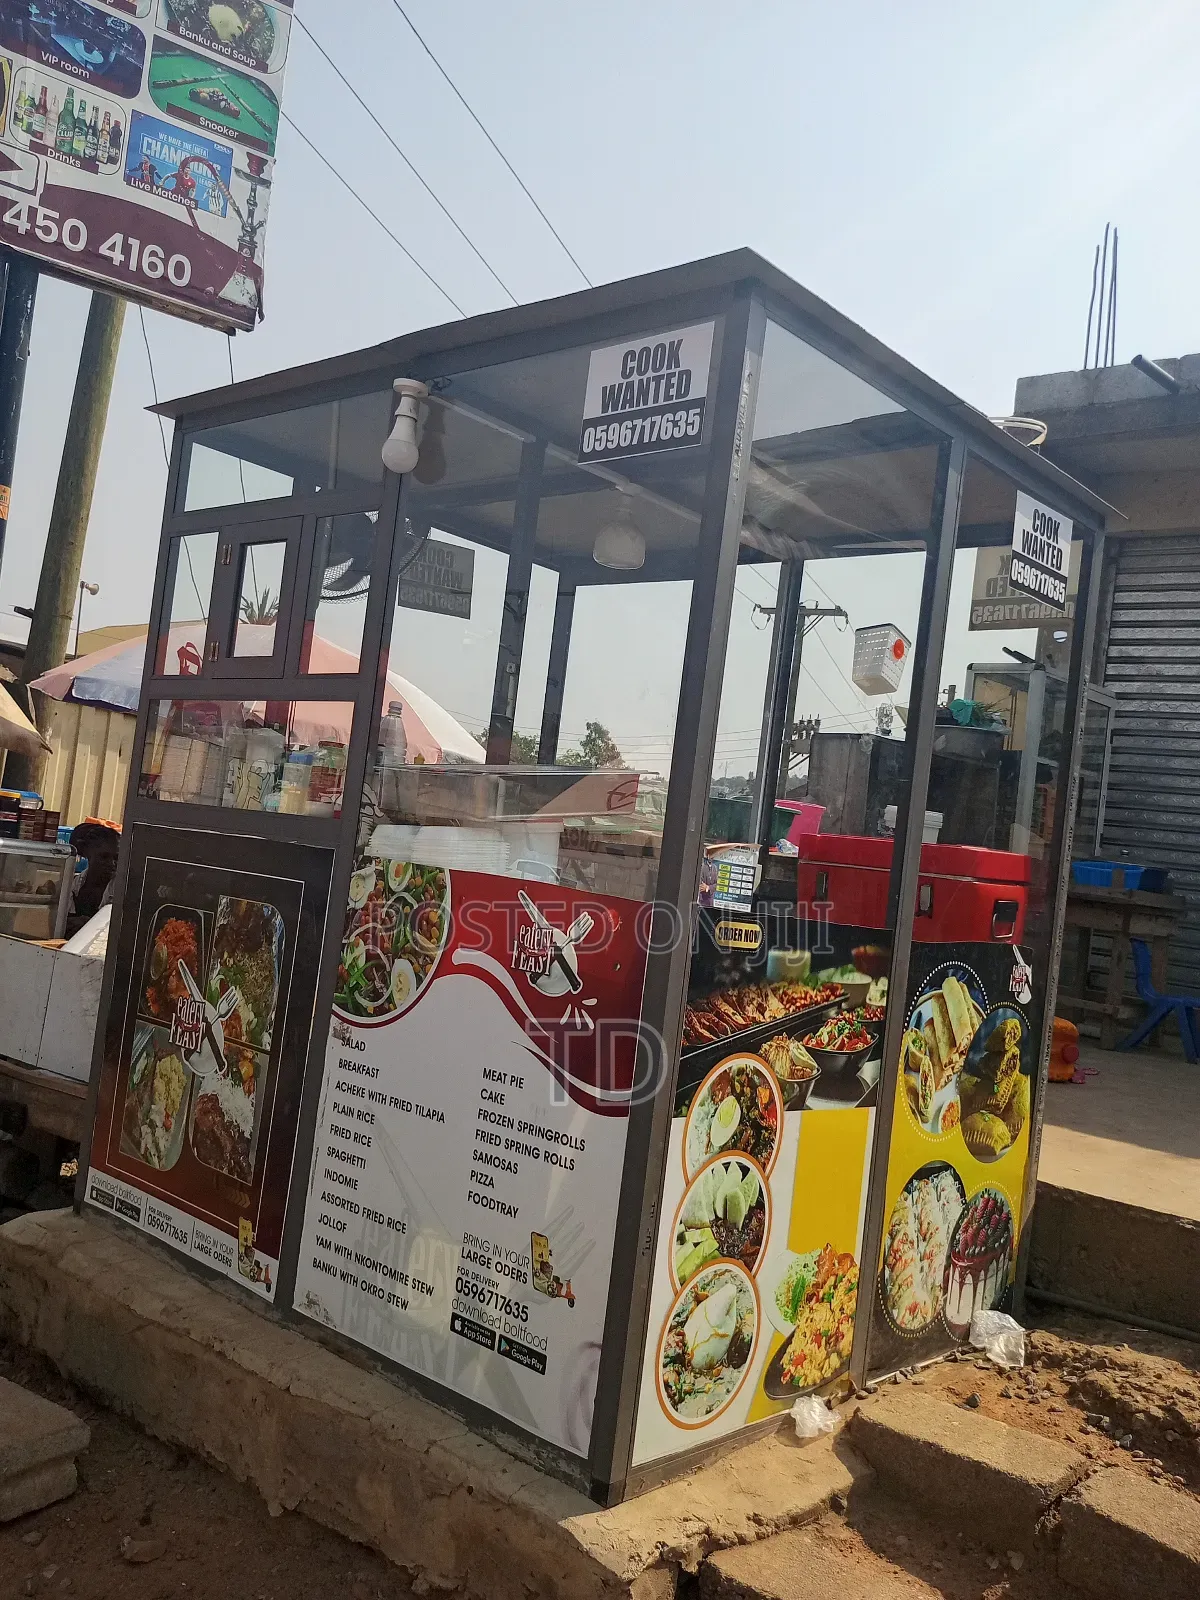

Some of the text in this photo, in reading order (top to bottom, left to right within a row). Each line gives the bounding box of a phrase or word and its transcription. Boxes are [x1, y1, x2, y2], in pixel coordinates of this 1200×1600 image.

[179, 26, 256, 67] Banku and Soup
[41, 50, 90, 79] VIP room
[199, 117, 239, 138] Snooker
[47, 148, 81, 168] Drinks
[131, 178, 196, 208] Live Matches
[2, 199, 192, 287] 450 4160
[620, 338, 684, 380] COOK
[601, 369, 692, 414] WANTED
[582, 408, 701, 454] 0596717635
[1032, 508, 1061, 545] COOK
[1021, 529, 1063, 572] WANTED
[1011, 558, 1066, 604] 0596717635
[519, 922, 554, 954] eatery
[718, 926, 761, 944] ORDER NOW
[511, 940, 555, 975] FEAST
[177, 995, 206, 1025] eatery
[341, 1037, 366, 1052] SALAD
[338, 1058, 379, 1079] BREAKFAST
[482, 1067, 525, 1089] MEAT PIE
[335, 1080, 445, 1124] ACHEKE WITH FRIED TILAPIA
[480, 1088, 506, 1106] CAKE
[332, 1101, 375, 1125] PLAIN RICE
[329, 1123, 372, 1148] FRIED RICE
[477, 1108, 586, 1152] FROZEN SPRINGROLLS
[326, 1146, 366, 1170] SPAGHETTI
[472, 1149, 519, 1175] SAMOSAS
[475, 1129, 575, 1171] FRIED SPRING ROLLS
[323, 1168, 358, 1191] INDOMIE
[470, 1170, 495, 1189] PIZZA
[321, 1190, 407, 1234] ASSORTED FRIED RICE
[467, 1190, 519, 1219] FOODTRAY
[147, 1214, 188, 1244] 0596717635
[318, 1213, 347, 1233] JOLLOF
[193, 1240, 232, 1268] LARGE ODERS
[461, 1246, 528, 1285] LARGE ODERS
[463, 1232, 530, 1269] BRING IN YOUR
[316, 1235, 434, 1297] YAM WITH NKONTOMIRE STEW
[457, 1265, 500, 1290] FOR DELIVERY
[312, 1257, 409, 1311] BANKU WITH OKRO STEW
[455, 1276, 529, 1323] 0596717635
[452, 1296, 548, 1352] download boltfood
[463, 1327, 492, 1346] App Store
[511, 1349, 543, 1371] Google Play
